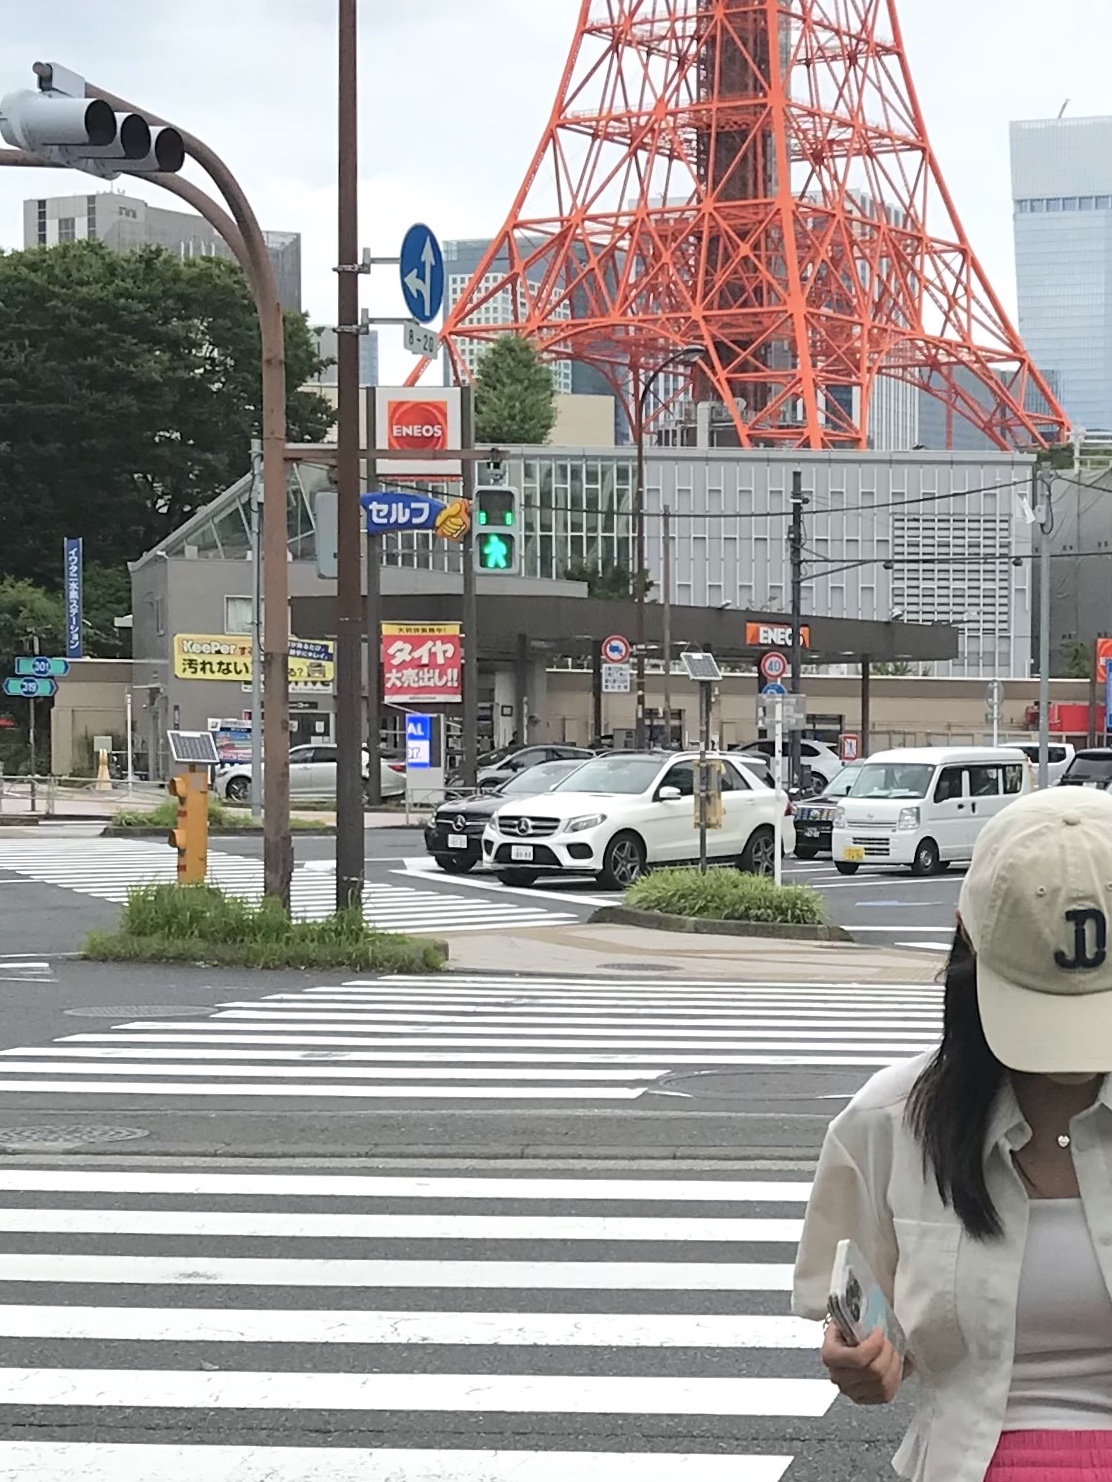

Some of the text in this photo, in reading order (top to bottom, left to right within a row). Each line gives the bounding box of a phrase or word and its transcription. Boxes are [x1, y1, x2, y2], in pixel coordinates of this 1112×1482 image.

[409, 329, 434, 353] 8-20
[392, 425, 442, 437] ENEOS
[368, 501, 430, 524] セルフ
[182, 639, 236, 655] KeePer
[387, 640, 454, 665] タイヤ
[34, 661, 49, 672] 301
[768, 660, 781, 672] 40
[385, 667, 458, 689] 大売出し!!
[22, 681, 37, 692] 319
